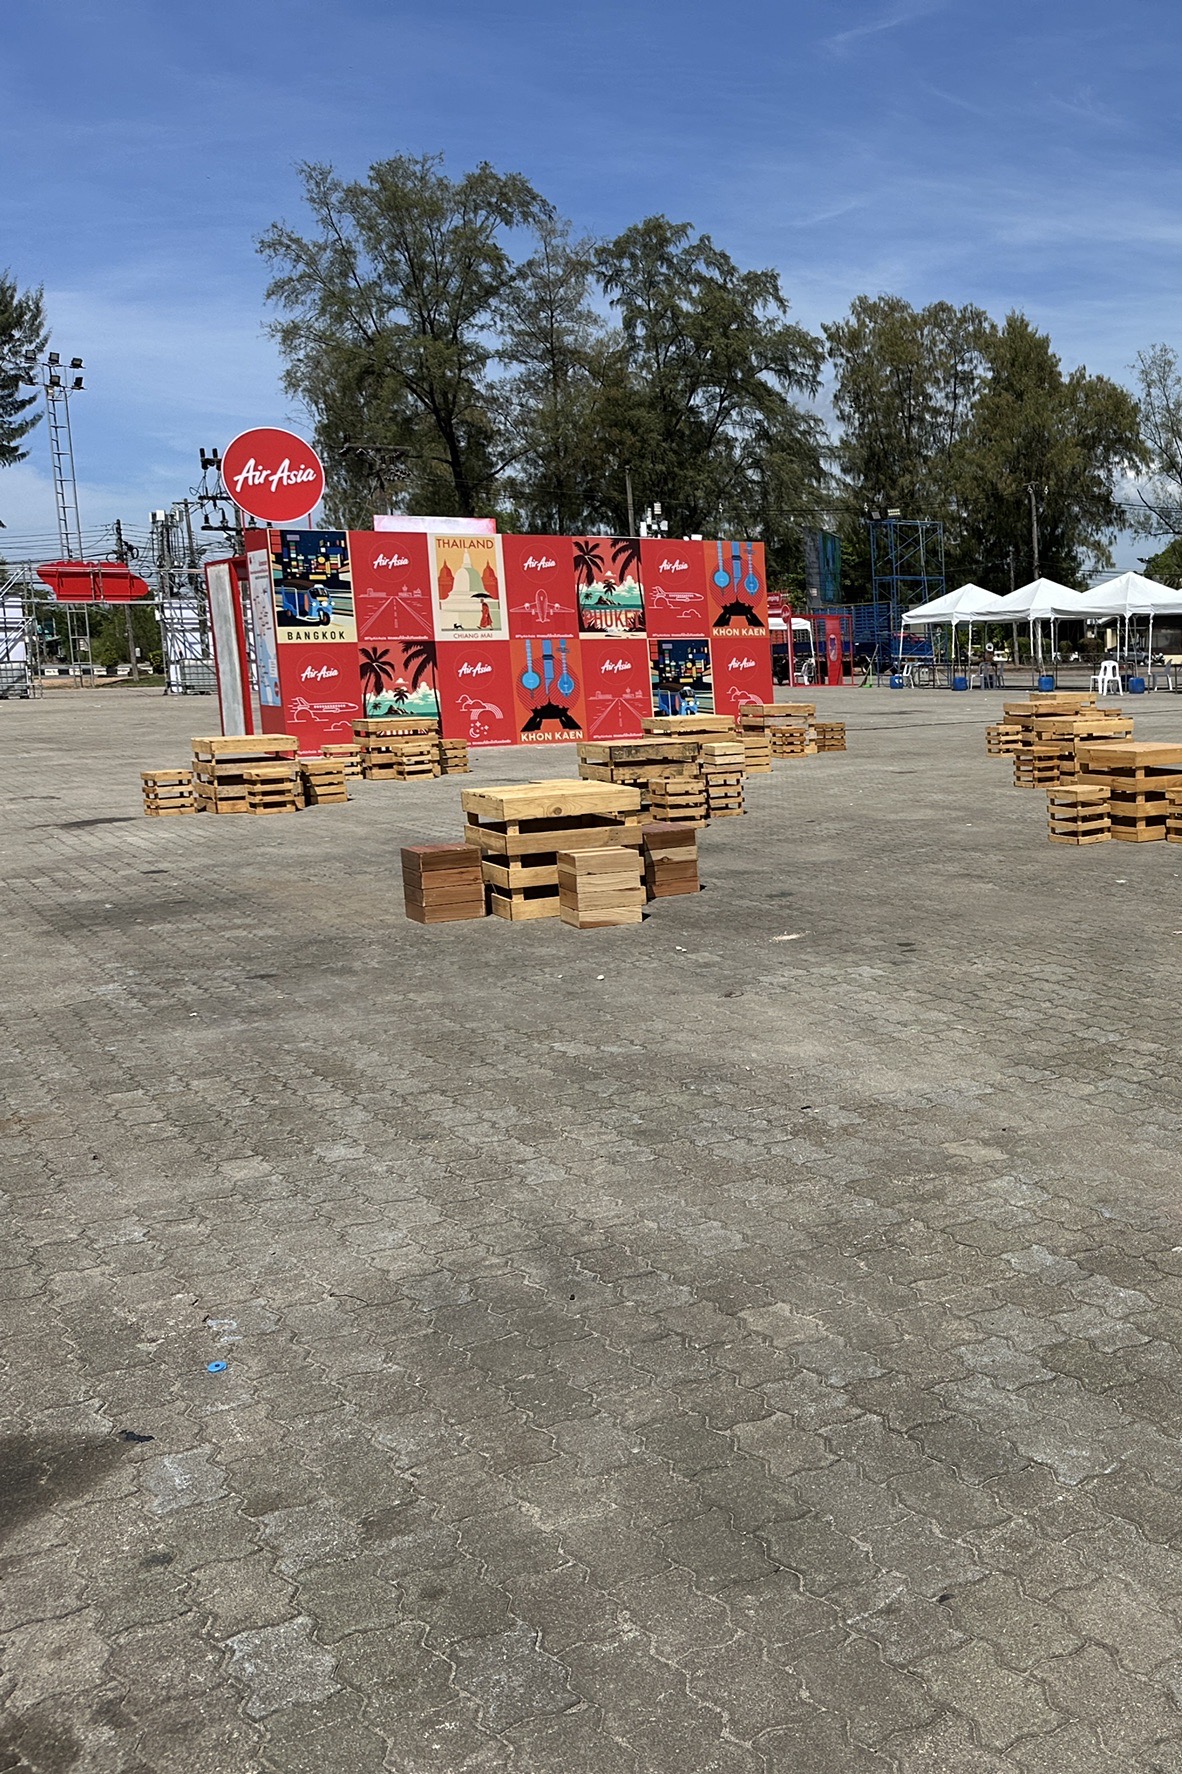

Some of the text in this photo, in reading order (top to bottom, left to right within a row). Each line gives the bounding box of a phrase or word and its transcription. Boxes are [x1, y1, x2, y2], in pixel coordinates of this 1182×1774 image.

[233, 458, 317, 493] AirAsia
[436, 538, 494, 550] THAILAND
[373, 553, 409, 568] AirAsia
[523, 556, 556, 571] AirAsia
[658, 559, 689, 573] AirAsia
[583, 609, 642, 629] PHUKET
[287, 630, 345, 641] BANGKOK
[713, 628, 739, 636] KHON
[742, 628, 766, 636] KAEN
[458, 663, 492, 678] AirAsia
[601, 659, 632, 674] AirAsia
[728, 657, 756, 671] AirAsia
[301, 665, 339, 682] AirAsia
[521, 732, 552, 742] KHON
[554, 730, 583, 741] KAEN
